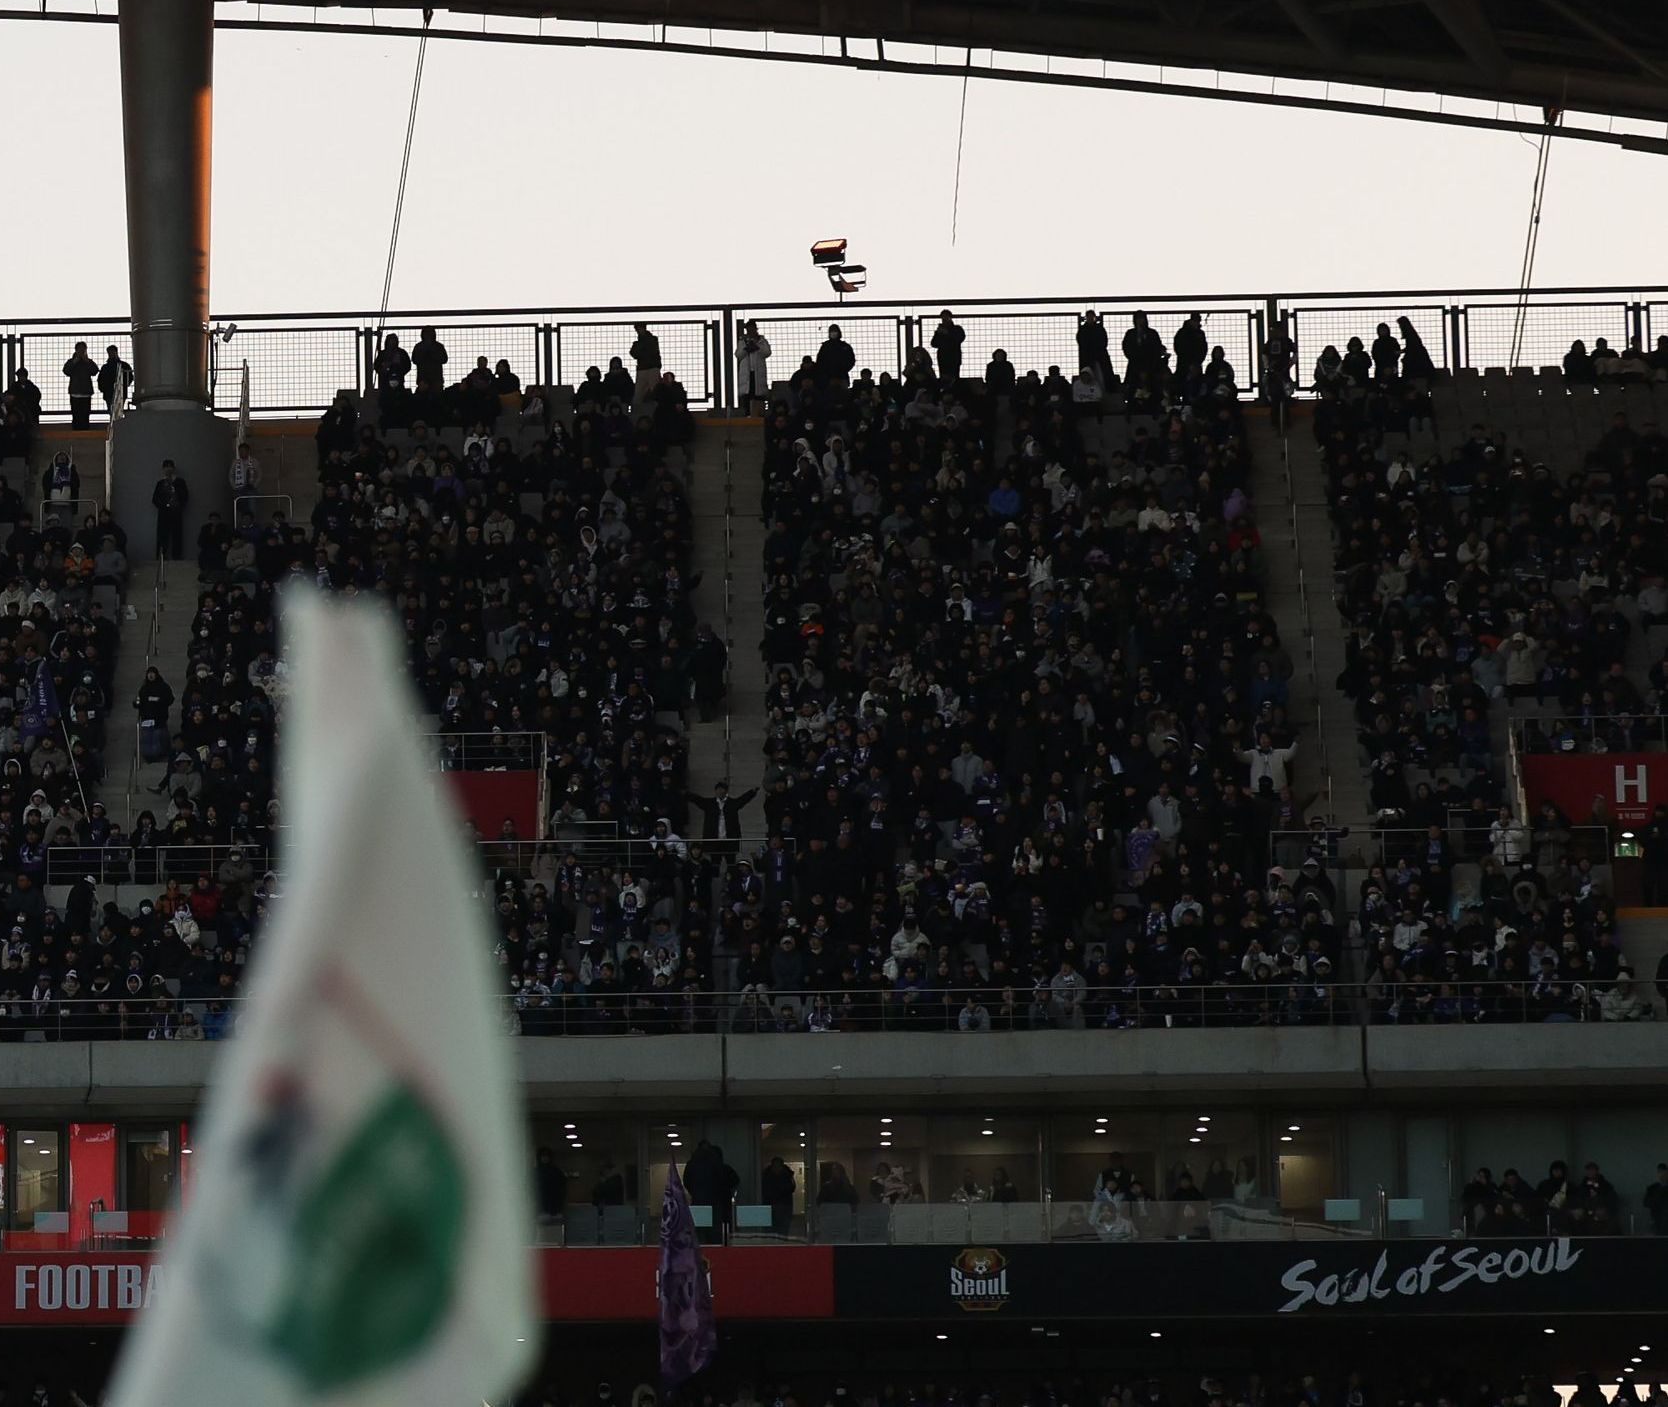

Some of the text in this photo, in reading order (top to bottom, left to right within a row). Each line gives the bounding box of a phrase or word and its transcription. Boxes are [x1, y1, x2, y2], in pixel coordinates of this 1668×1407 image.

[1615, 765, 1646, 803] H
[951, 1266, 1009, 1296] Seoul
[1395, 1245, 1446, 1295] of
[1436, 1237, 1582, 1291] Seoul
